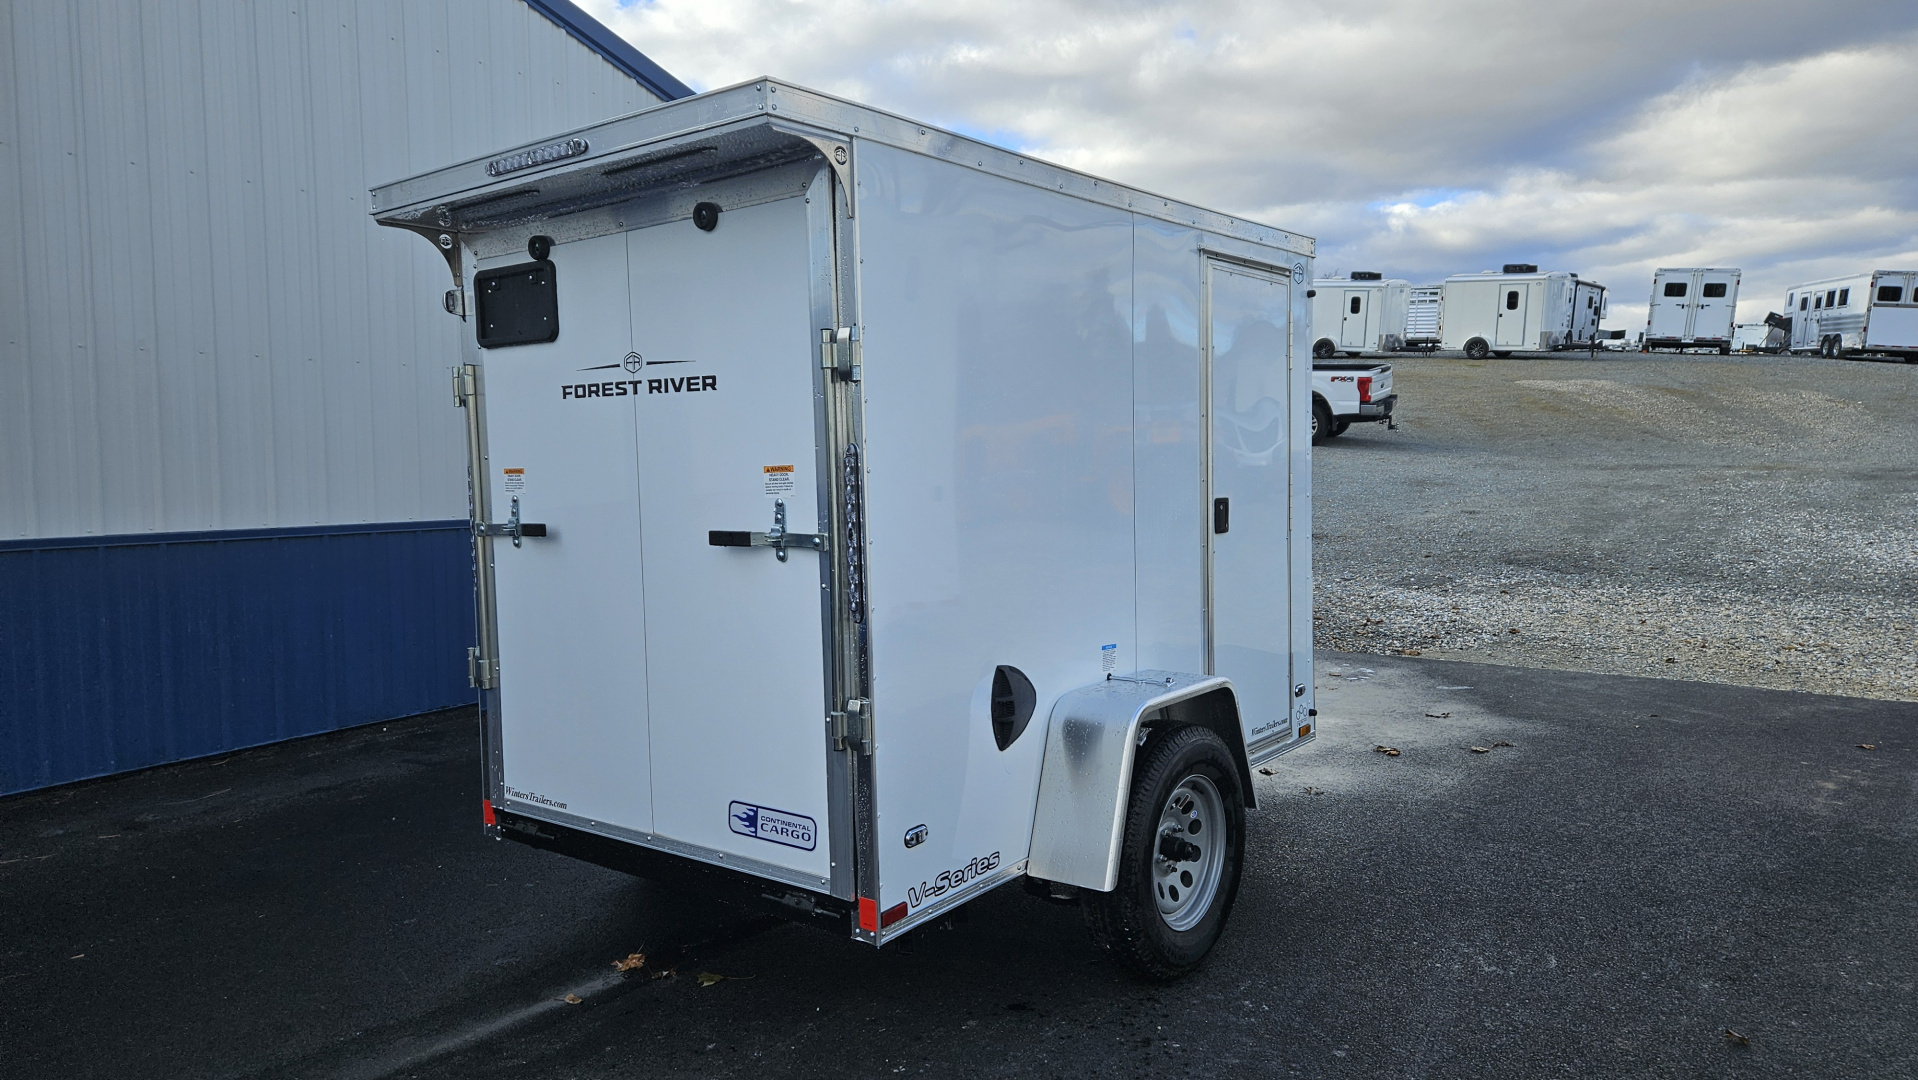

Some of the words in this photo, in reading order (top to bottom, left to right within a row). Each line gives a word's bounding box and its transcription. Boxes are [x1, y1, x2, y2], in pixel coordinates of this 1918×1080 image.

[561, 380, 642, 399] FOREST
[647, 375, 717, 394] RIVER
[506, 786, 567, 809] WintersTrailers.com
[760, 823, 811, 841] CARGO
[761, 816, 811, 831] CONTINENTAL
[908, 851, 1000, 908] V-Series
